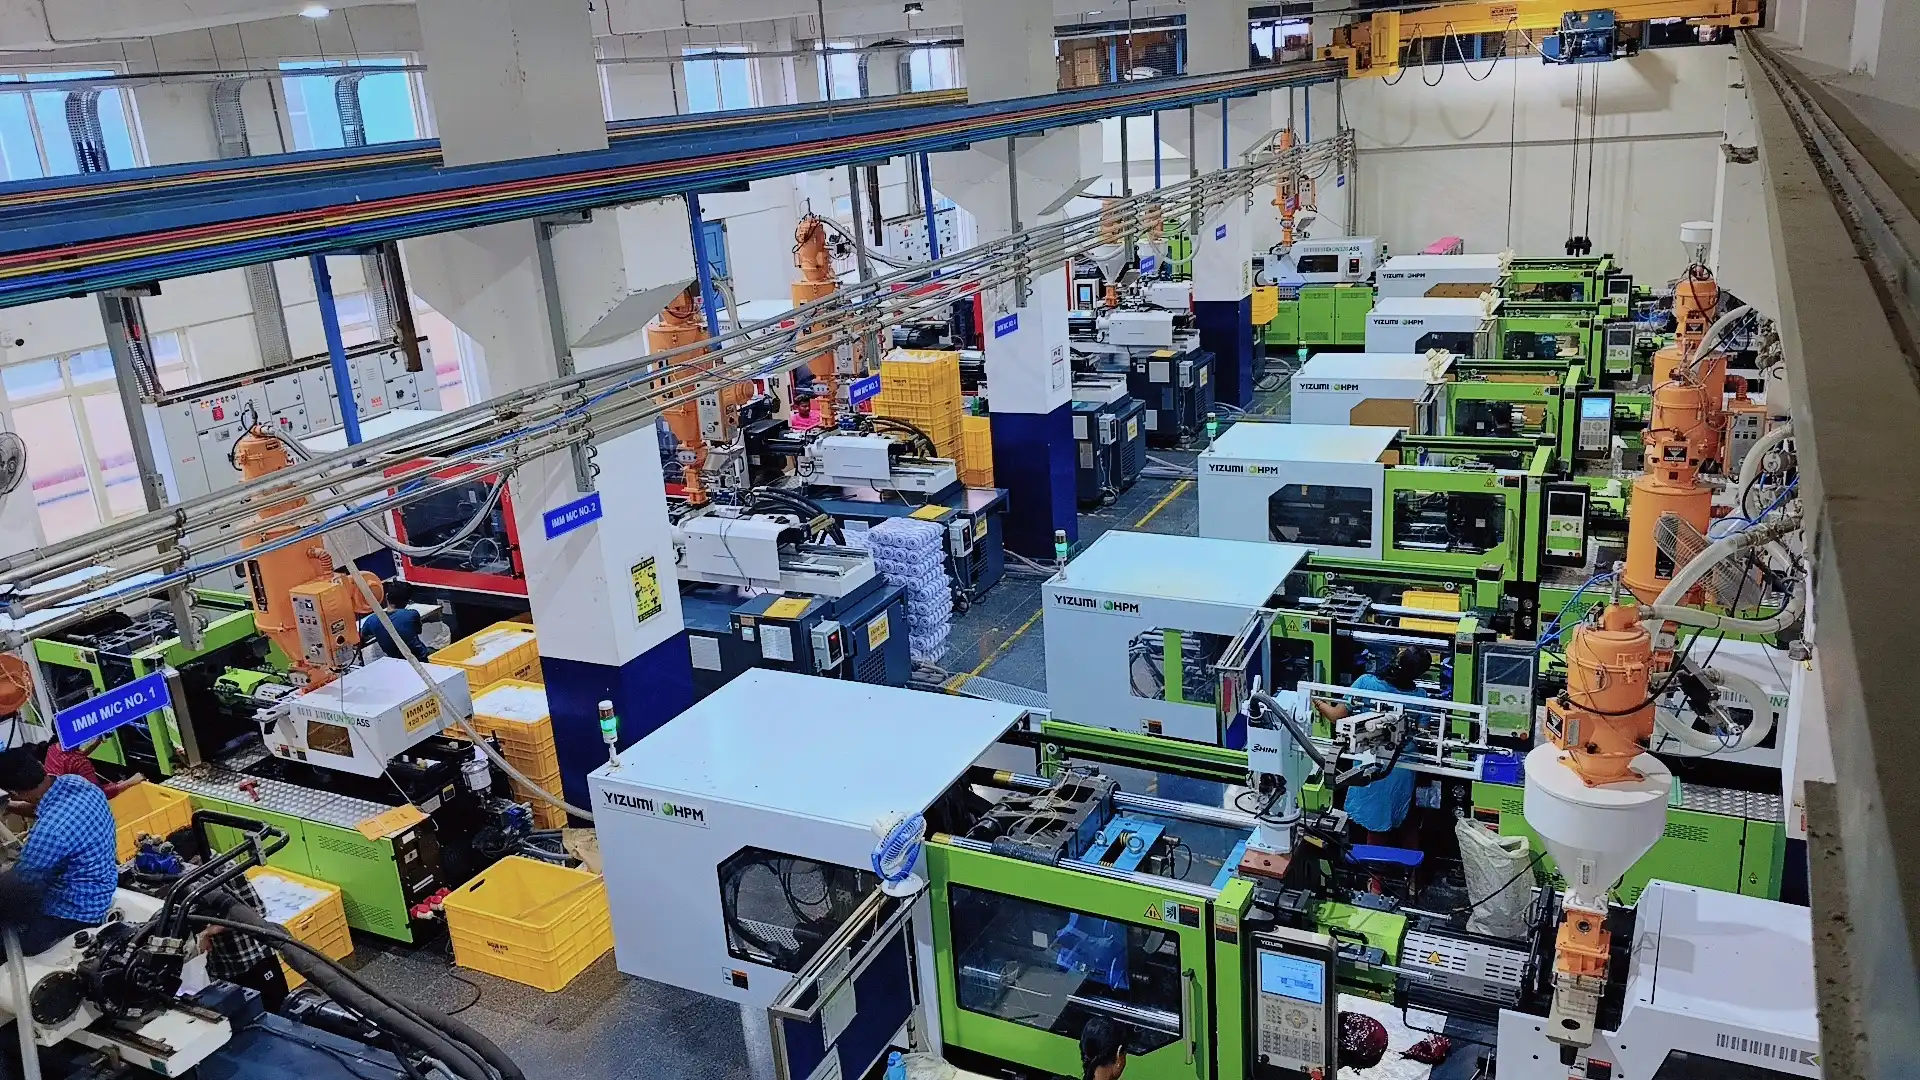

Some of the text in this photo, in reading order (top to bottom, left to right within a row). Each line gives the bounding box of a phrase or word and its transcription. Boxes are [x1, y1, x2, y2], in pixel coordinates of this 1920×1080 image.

[1340, 383, 1359, 391] HPM
[1208, 463, 1278, 475] YIZUMI HPM
[551, 502, 597, 529] IMM M/C NO. 2
[1053, 593, 1139, 613] YIZUMI HPM
[72, 686, 156, 733] IMM M/C NO. 1
[406, 698, 436, 719] IMM 02
[421, 707, 437, 721] TONS
[356, 717, 371, 728] A5S
[603, 790, 705, 822] YIZUMI HPM
[264, 970, 274, 981] 03
